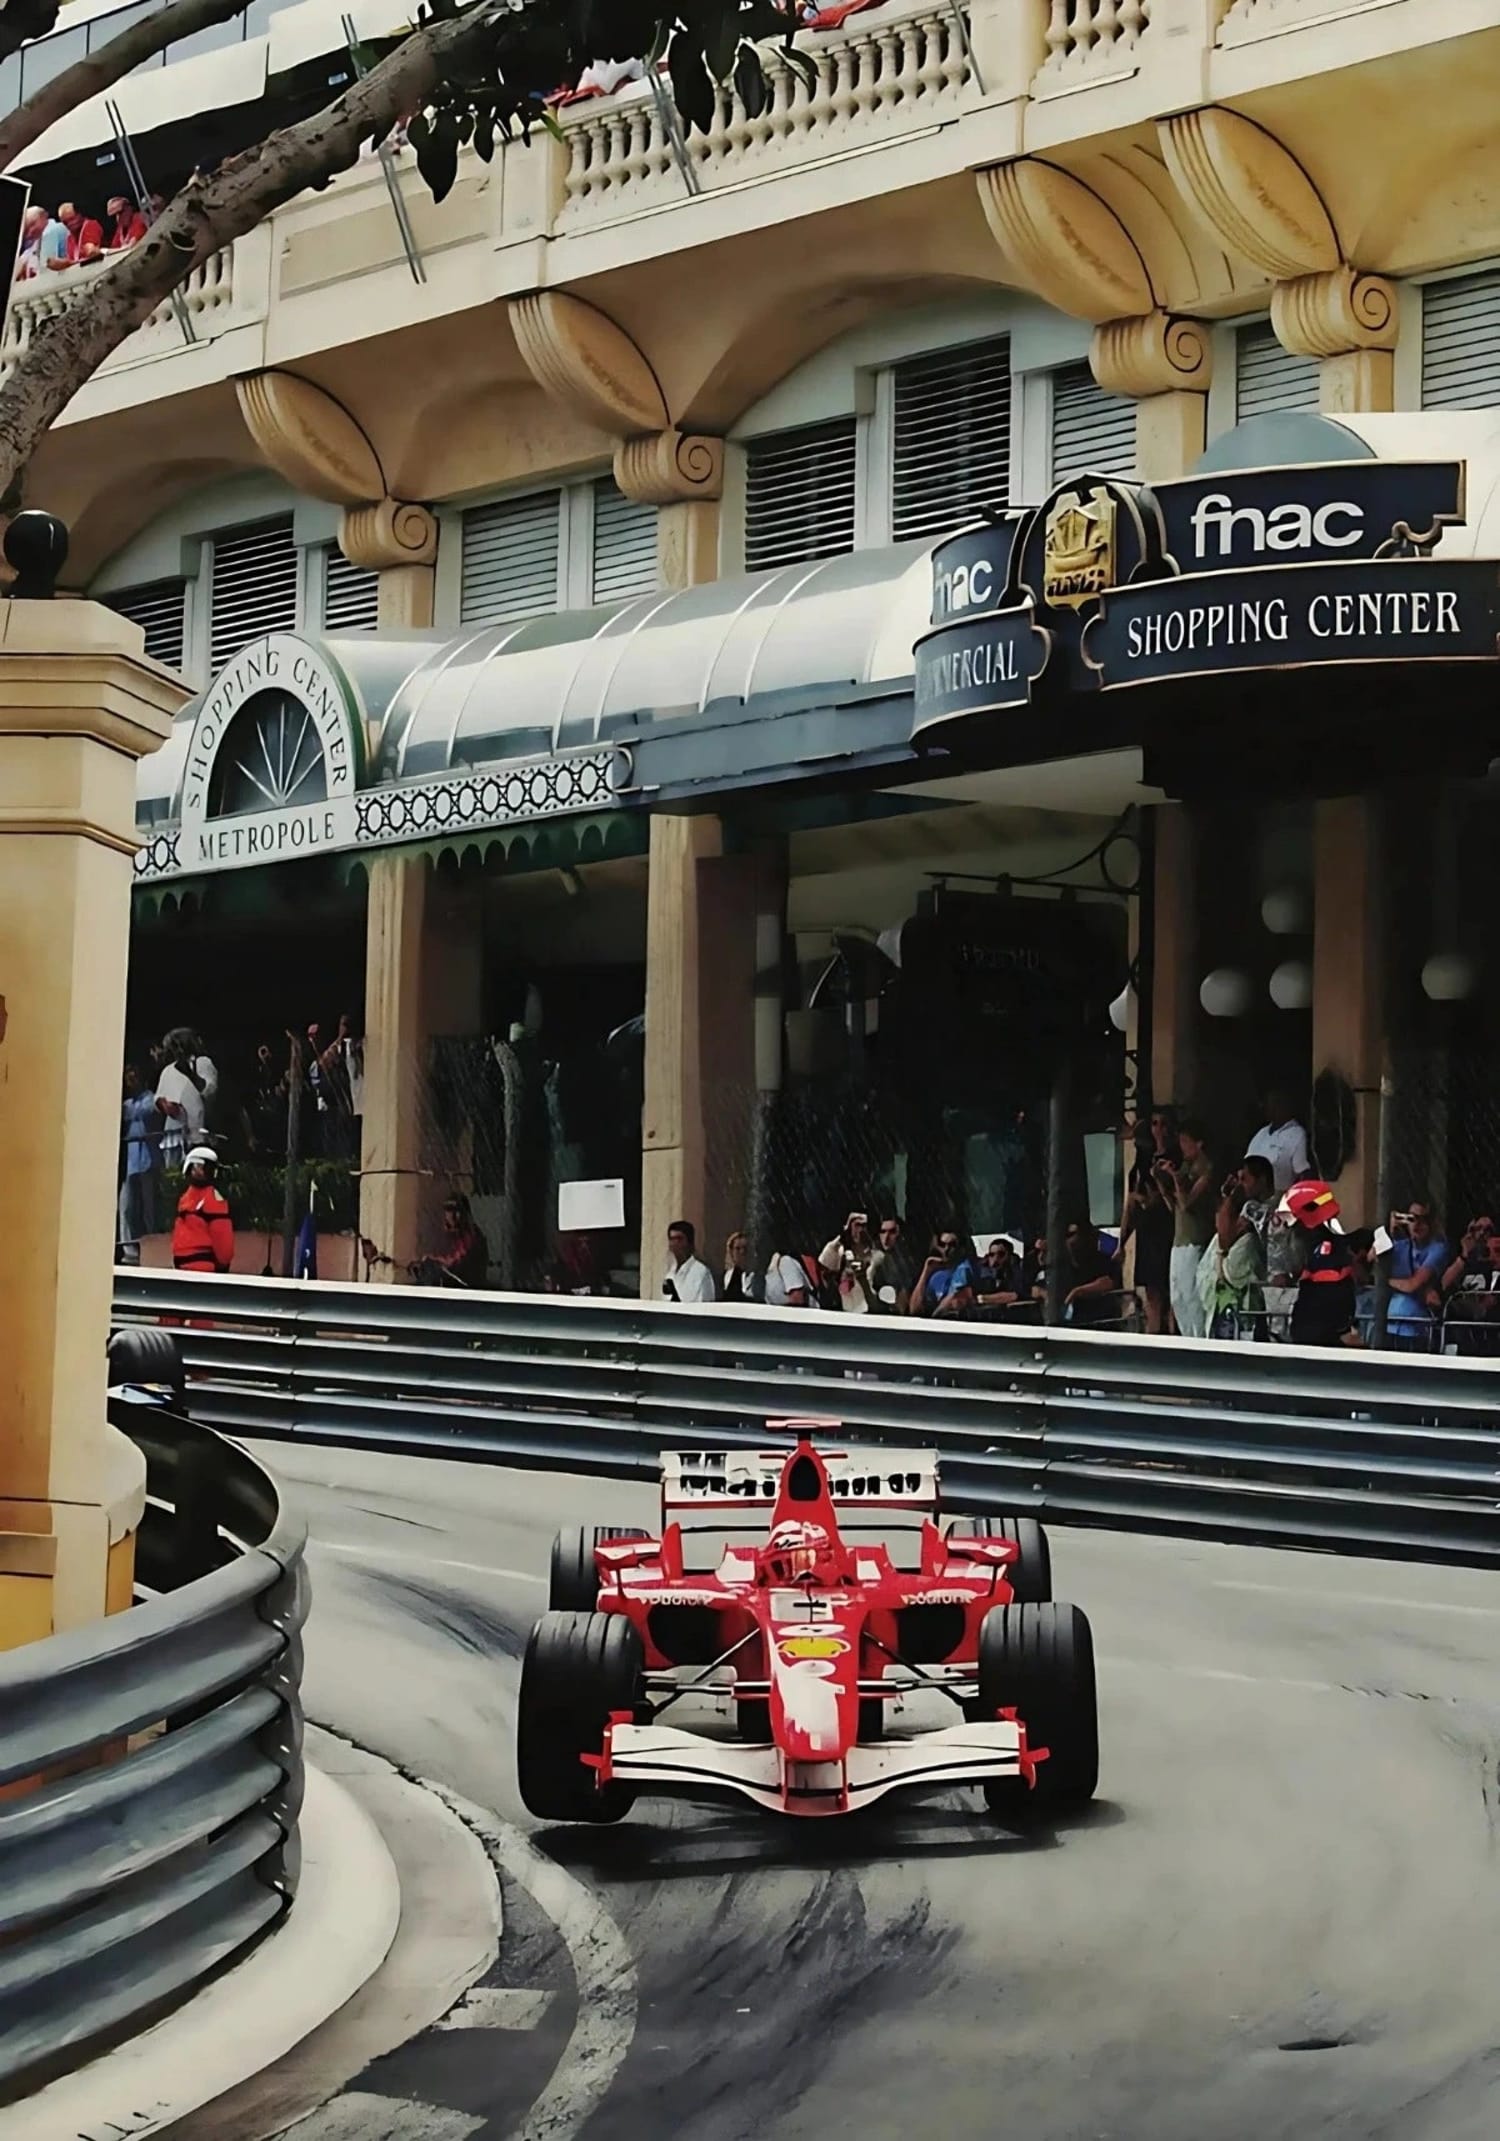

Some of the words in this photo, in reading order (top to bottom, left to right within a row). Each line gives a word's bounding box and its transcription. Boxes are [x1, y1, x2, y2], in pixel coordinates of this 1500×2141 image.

[1190, 494, 1365, 558] fnac
[1127, 599, 1288, 658] SHOPPING
[1308, 591, 1461, 637] CENTER
[922, 639, 1020, 697] MERCIAL
[189, 652, 280, 808] SHOPPING
[293, 658, 349, 785] CENTER
[199, 813, 334, 860] METROPOLE
